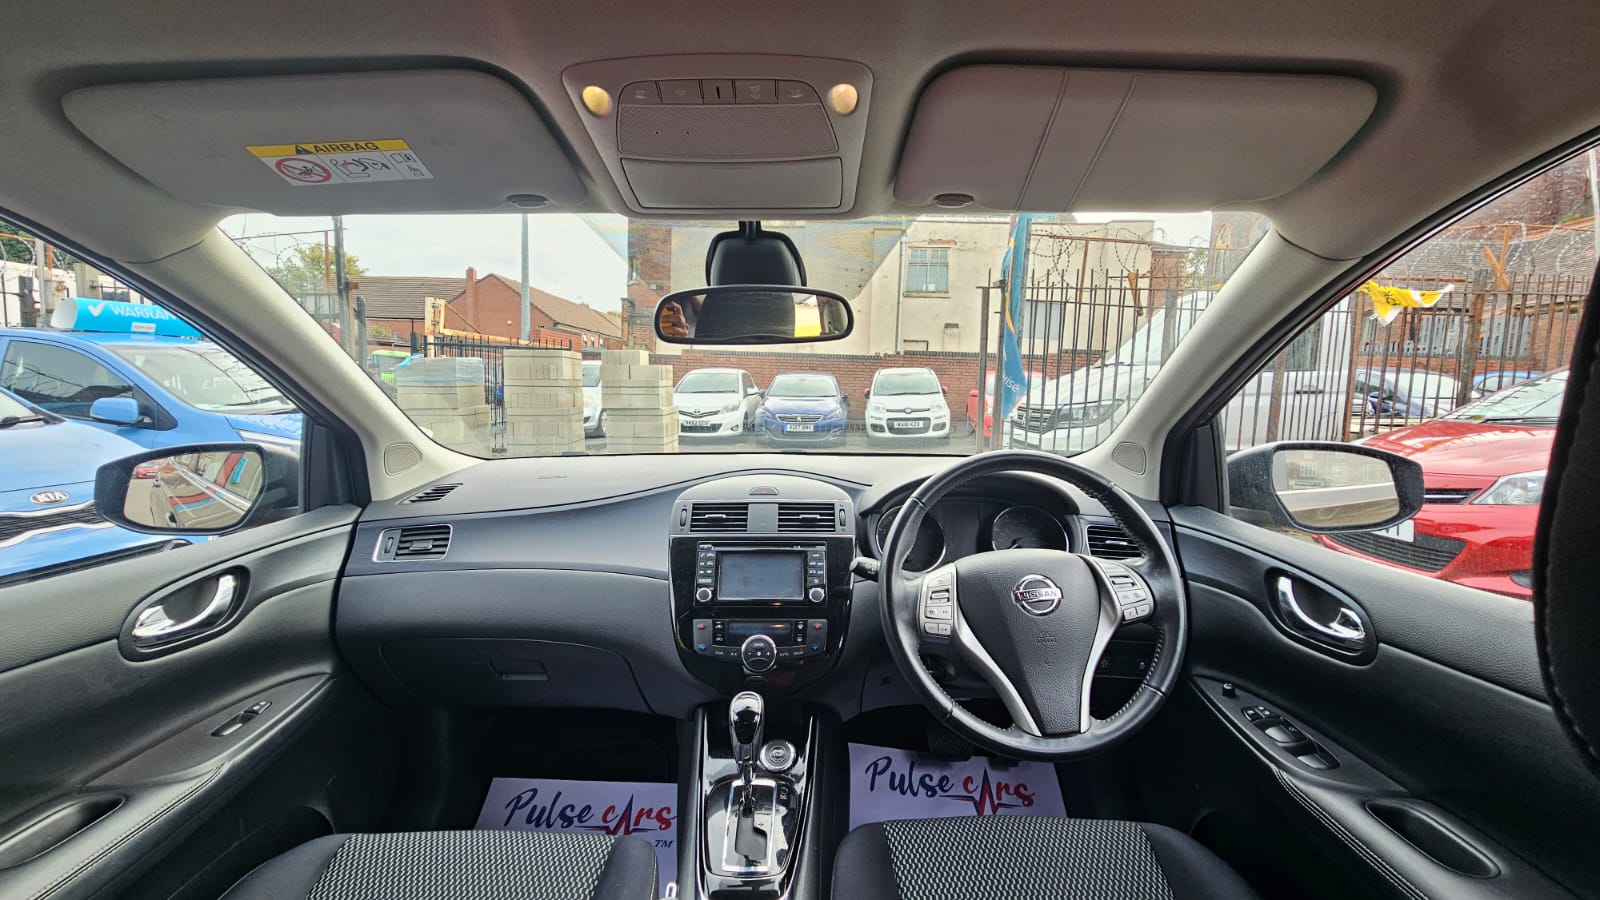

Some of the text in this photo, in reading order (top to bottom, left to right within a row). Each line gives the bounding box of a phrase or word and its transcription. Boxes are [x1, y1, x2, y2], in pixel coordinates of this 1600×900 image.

[313, 142, 380, 154] AIRBAG
[1016, 590, 1058, 602] NISSAN
[865, 756, 954, 798] Pulse
[504, 791, 594, 829] Pulse
[654, 839, 674, 849] TM
